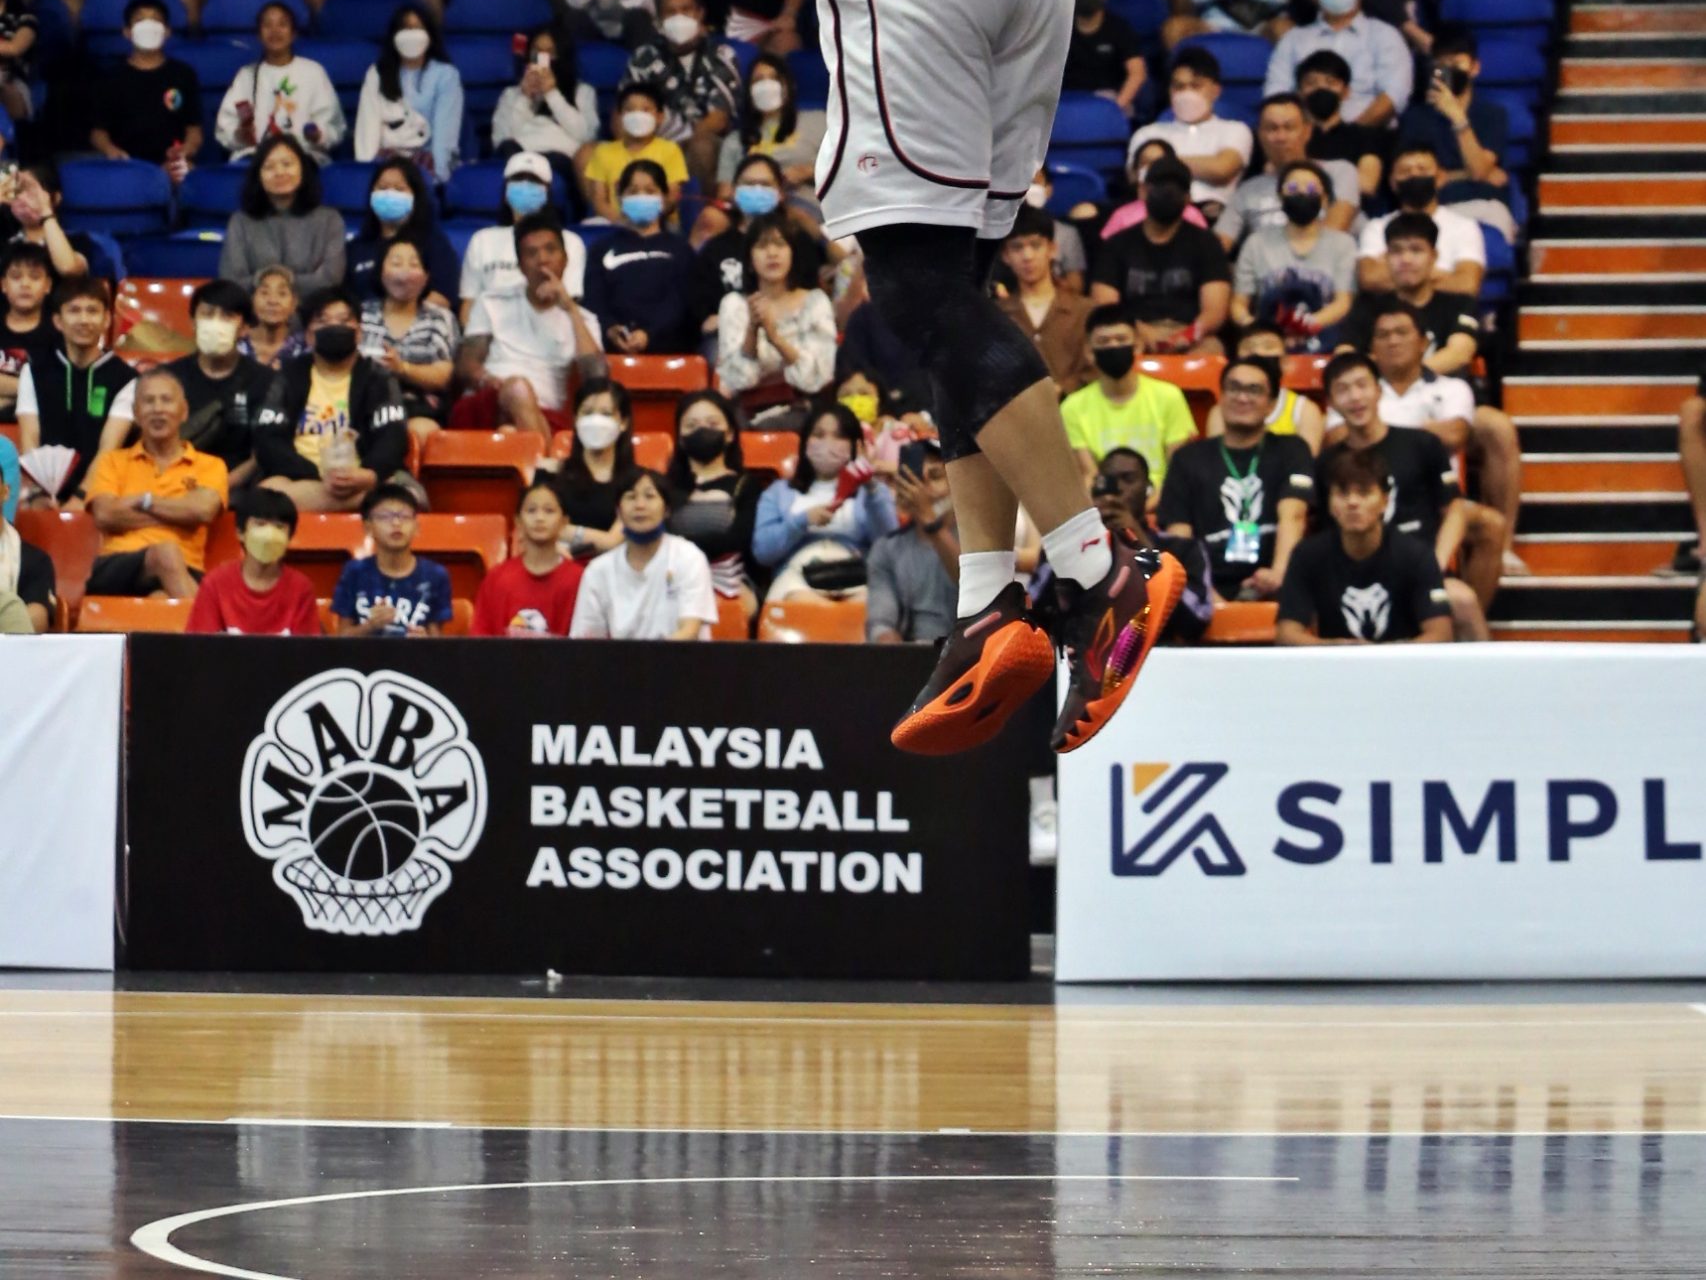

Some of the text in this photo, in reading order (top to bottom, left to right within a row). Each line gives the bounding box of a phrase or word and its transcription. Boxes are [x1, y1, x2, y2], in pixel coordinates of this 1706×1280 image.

[261, 695, 468, 833] MABA
[531, 724, 824, 770] MALAYSIA
[530, 785, 910, 832] BASKETBALL
[1272, 778, 1703, 865] SIMPL
[526, 846, 922, 894] ASSOCIATION
